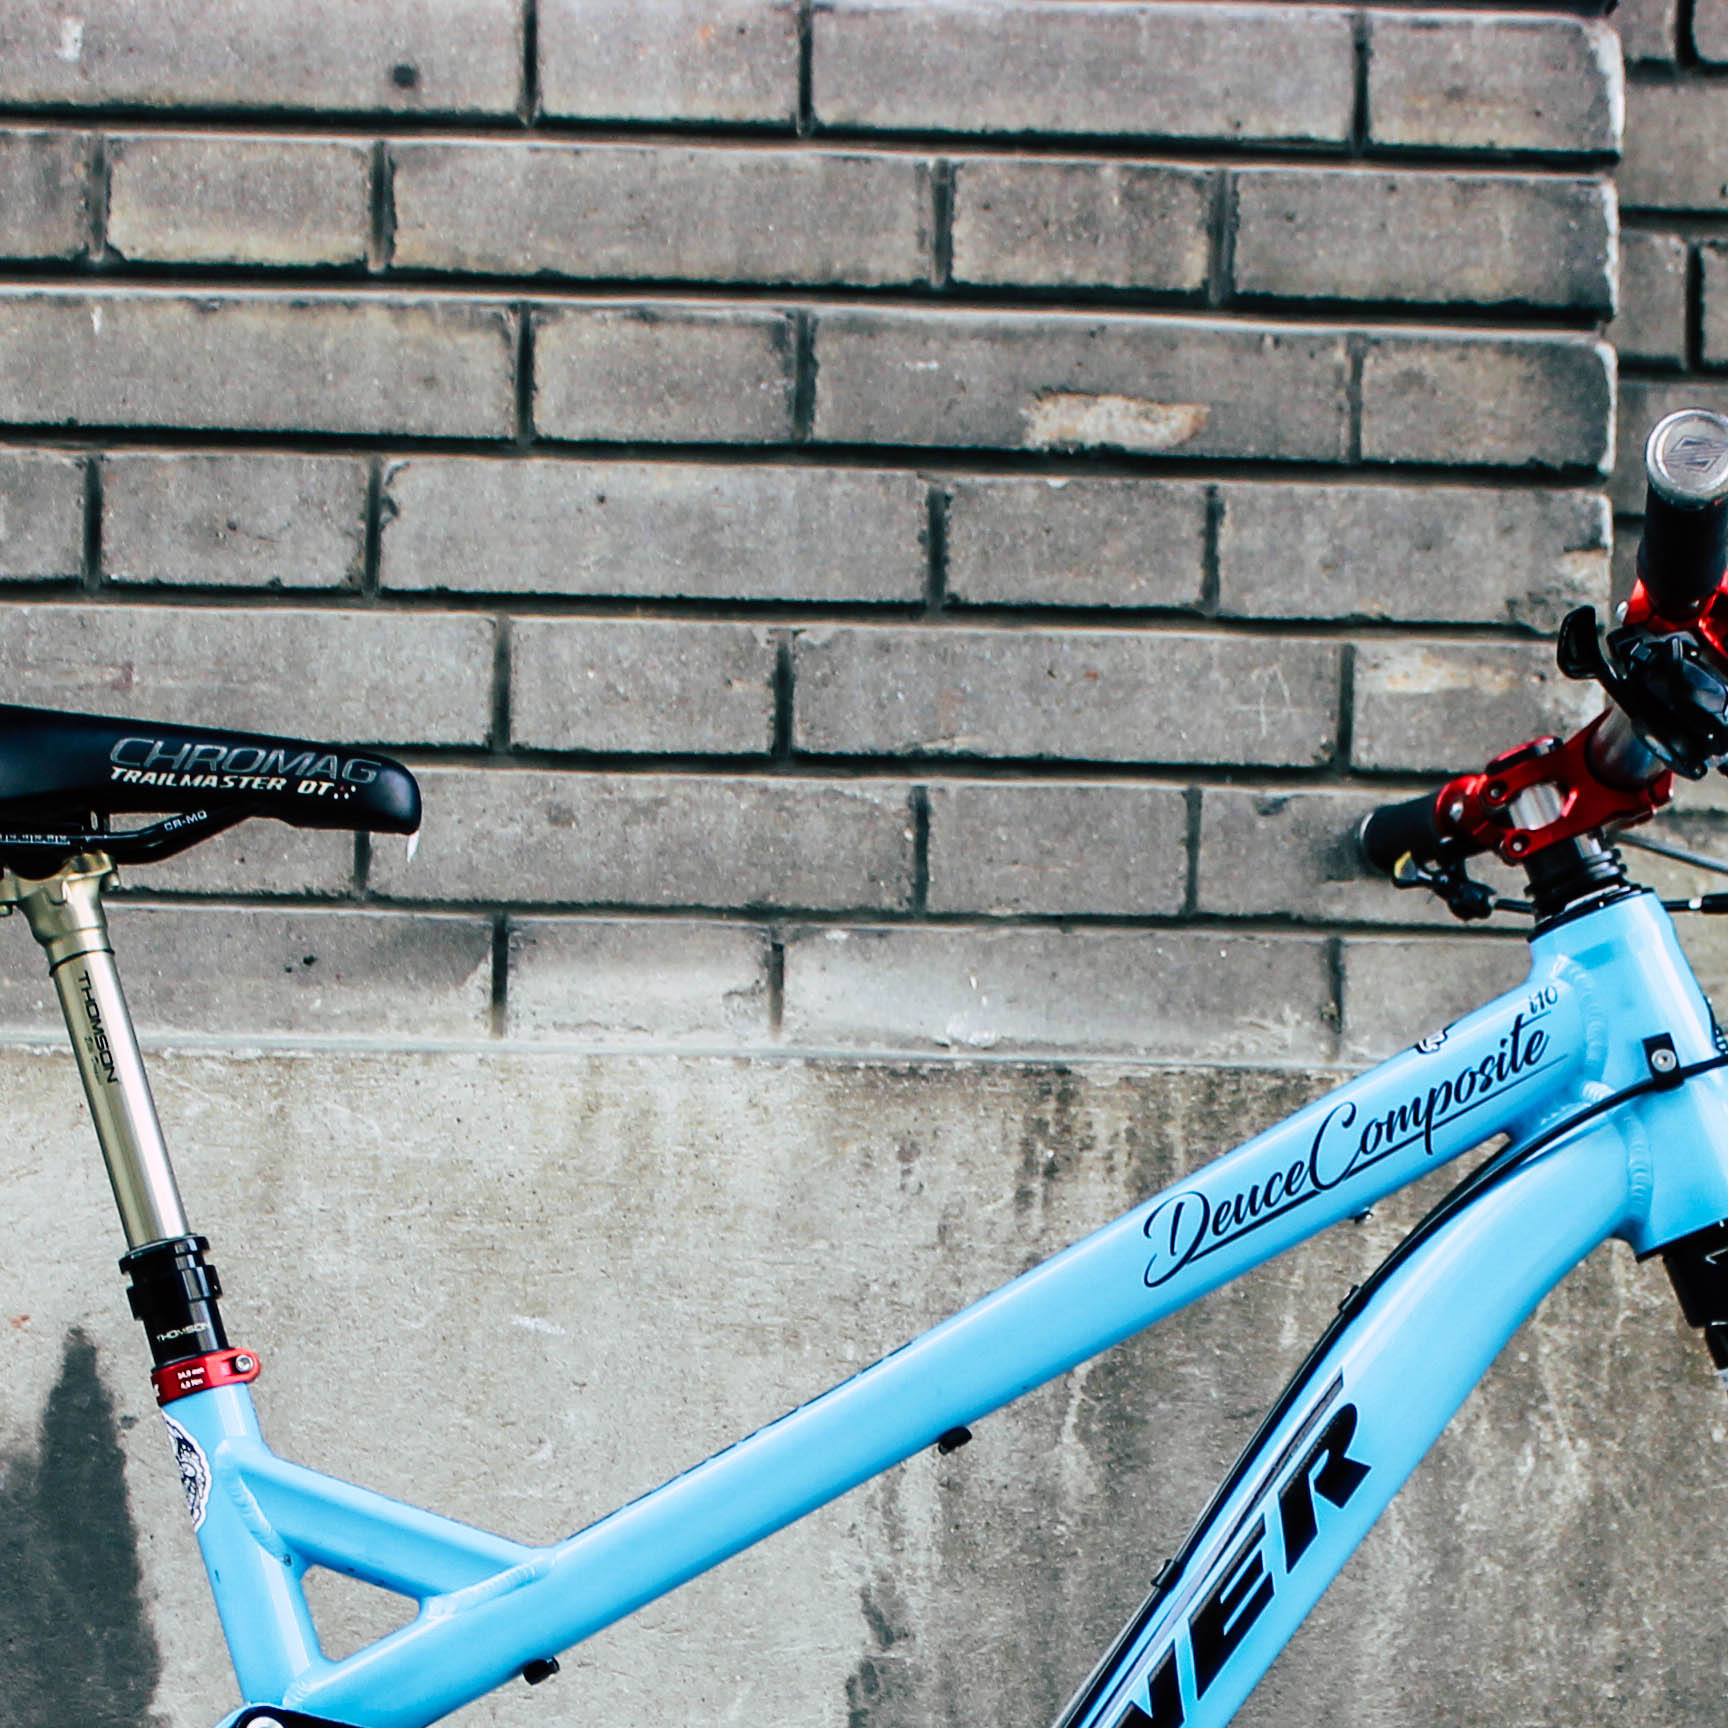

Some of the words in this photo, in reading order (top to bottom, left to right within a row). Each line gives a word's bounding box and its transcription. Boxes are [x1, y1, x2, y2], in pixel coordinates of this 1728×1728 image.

[109, 737, 382, 785] CHROMAG
[110, 765, 288, 791] TRAILMASTER
[297, 779, 335, 796] DT
[163, 809, 208, 832] CR-MO
[78, 969, 119, 1084] THOMSON
